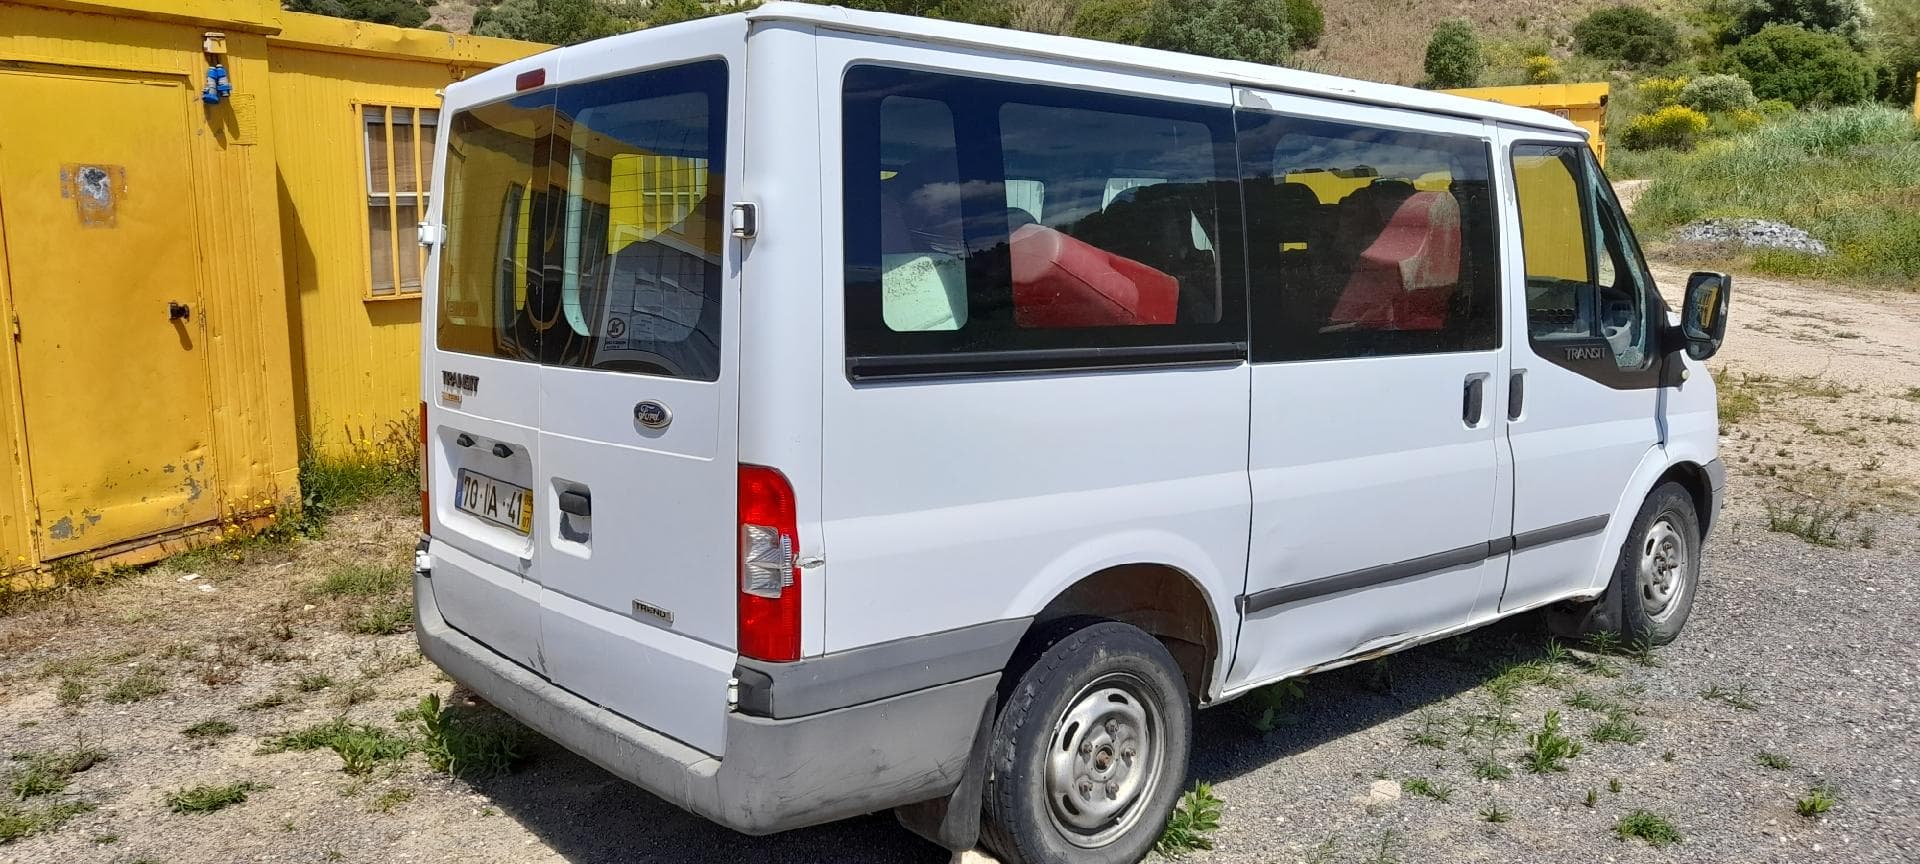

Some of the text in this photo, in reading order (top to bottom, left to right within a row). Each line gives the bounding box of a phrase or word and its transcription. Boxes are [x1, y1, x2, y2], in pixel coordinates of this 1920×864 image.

[1565, 348, 1607, 361] TRANSIT
[638, 404, 662, 422] Ford
[635, 602, 666, 618] TREND
